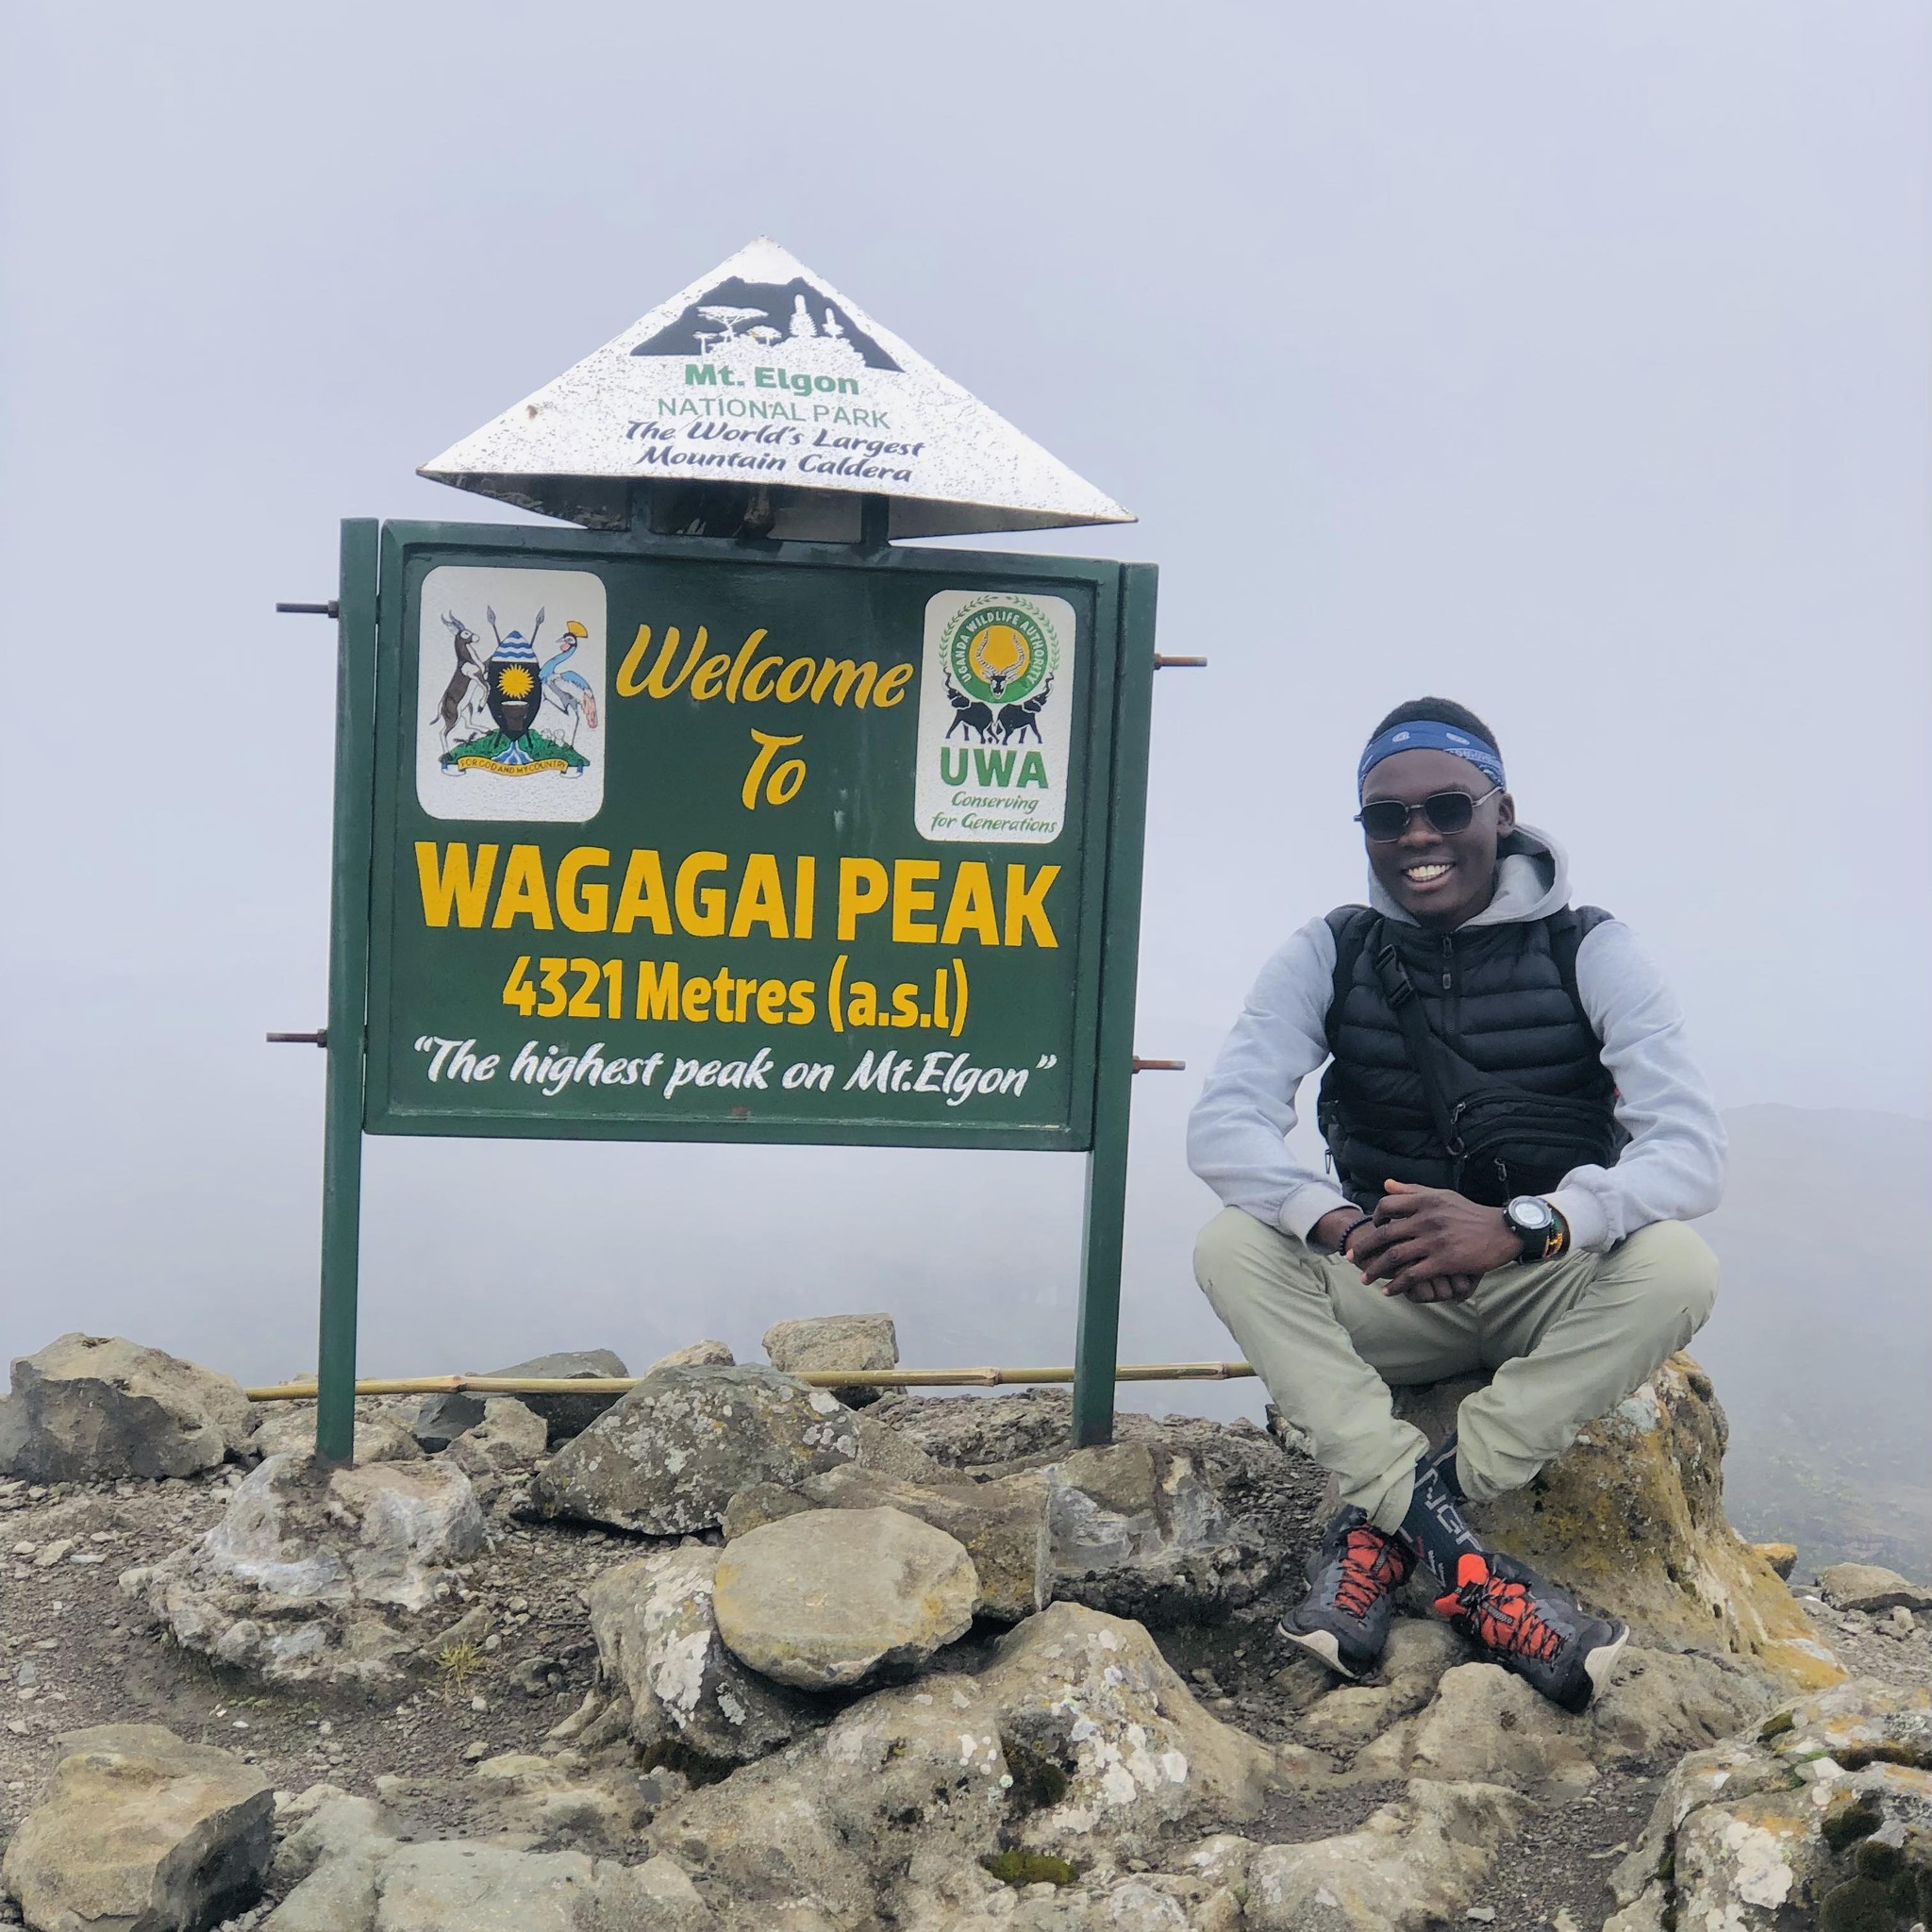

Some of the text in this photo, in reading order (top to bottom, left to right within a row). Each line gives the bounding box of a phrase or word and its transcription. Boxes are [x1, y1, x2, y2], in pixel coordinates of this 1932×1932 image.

[685, 363, 859, 397] Mt. Elgon
[658, 397, 891, 429] NATIONAL PARK
[625, 420, 925, 458] The World's Largest
[634, 445, 913, 482] Mountain Caldera
[615, 624, 914, 709] Welcome
[953, 610, 1046, 685] UGANDA WILDLIFE AUTHORITY
[460, 758, 477, 767] FOR
[741, 727, 807, 810] To
[941, 746, 1049, 789] UWA
[952, 791, 1040, 814] Conserving
[931, 812, 1058, 834] for Generations
[414, 841, 1062, 949] WAGAGAI PEAK
[502, 955, 969, 1038] 4321 Metres (a.s.l)
[509, 1040, 664, 1097] highest
[662, 1047, 774, 1100] peak
[781, 1058, 835, 1092] on
